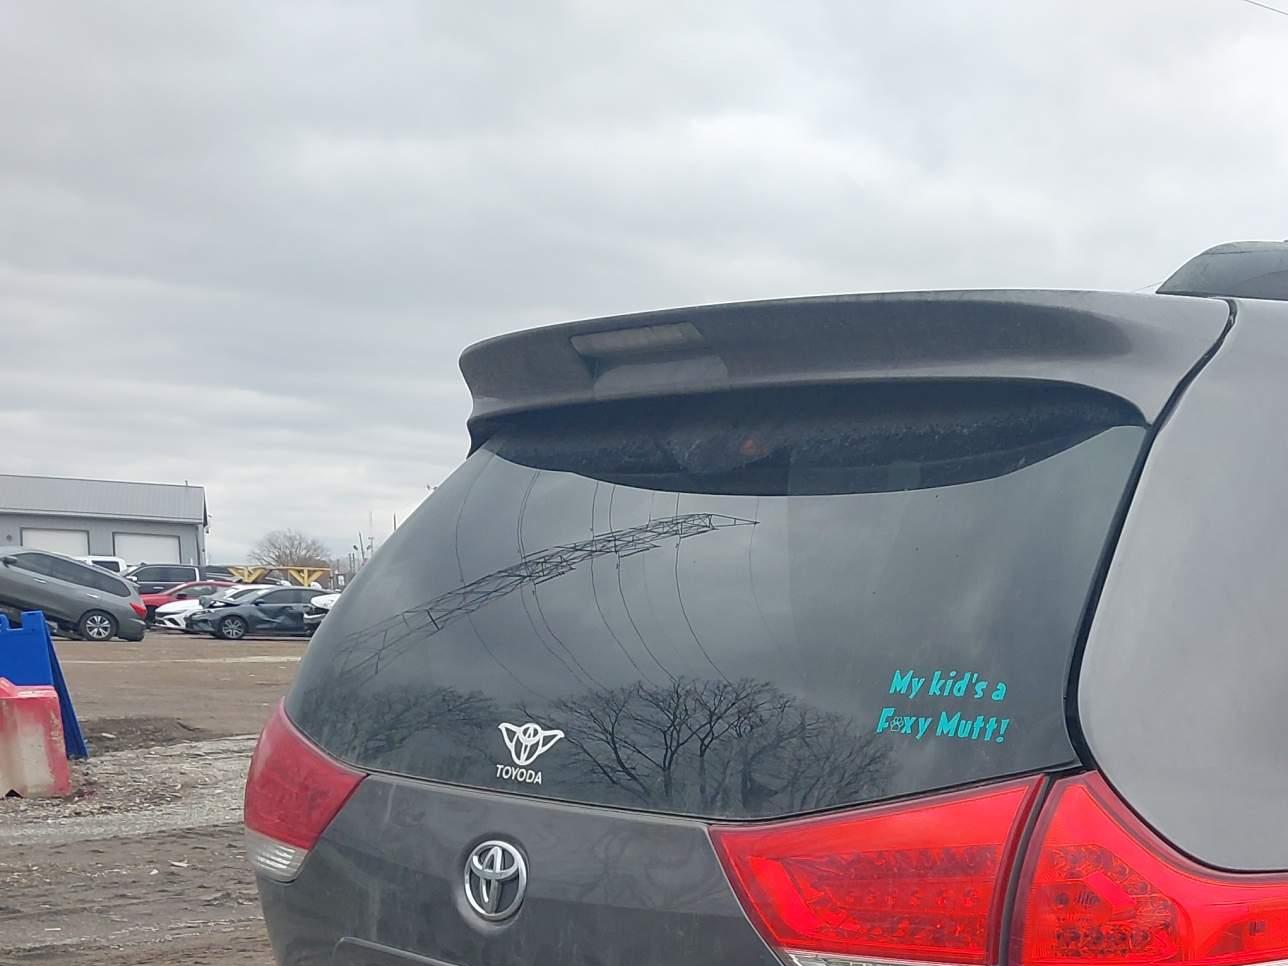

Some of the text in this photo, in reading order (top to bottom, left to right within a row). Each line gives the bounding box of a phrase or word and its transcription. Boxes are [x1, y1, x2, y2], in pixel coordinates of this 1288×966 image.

[889, 670, 1007, 701] My kid's a
[936, 711, 1010, 743] Mutt!
[496, 764, 542, 785] TOYODA
